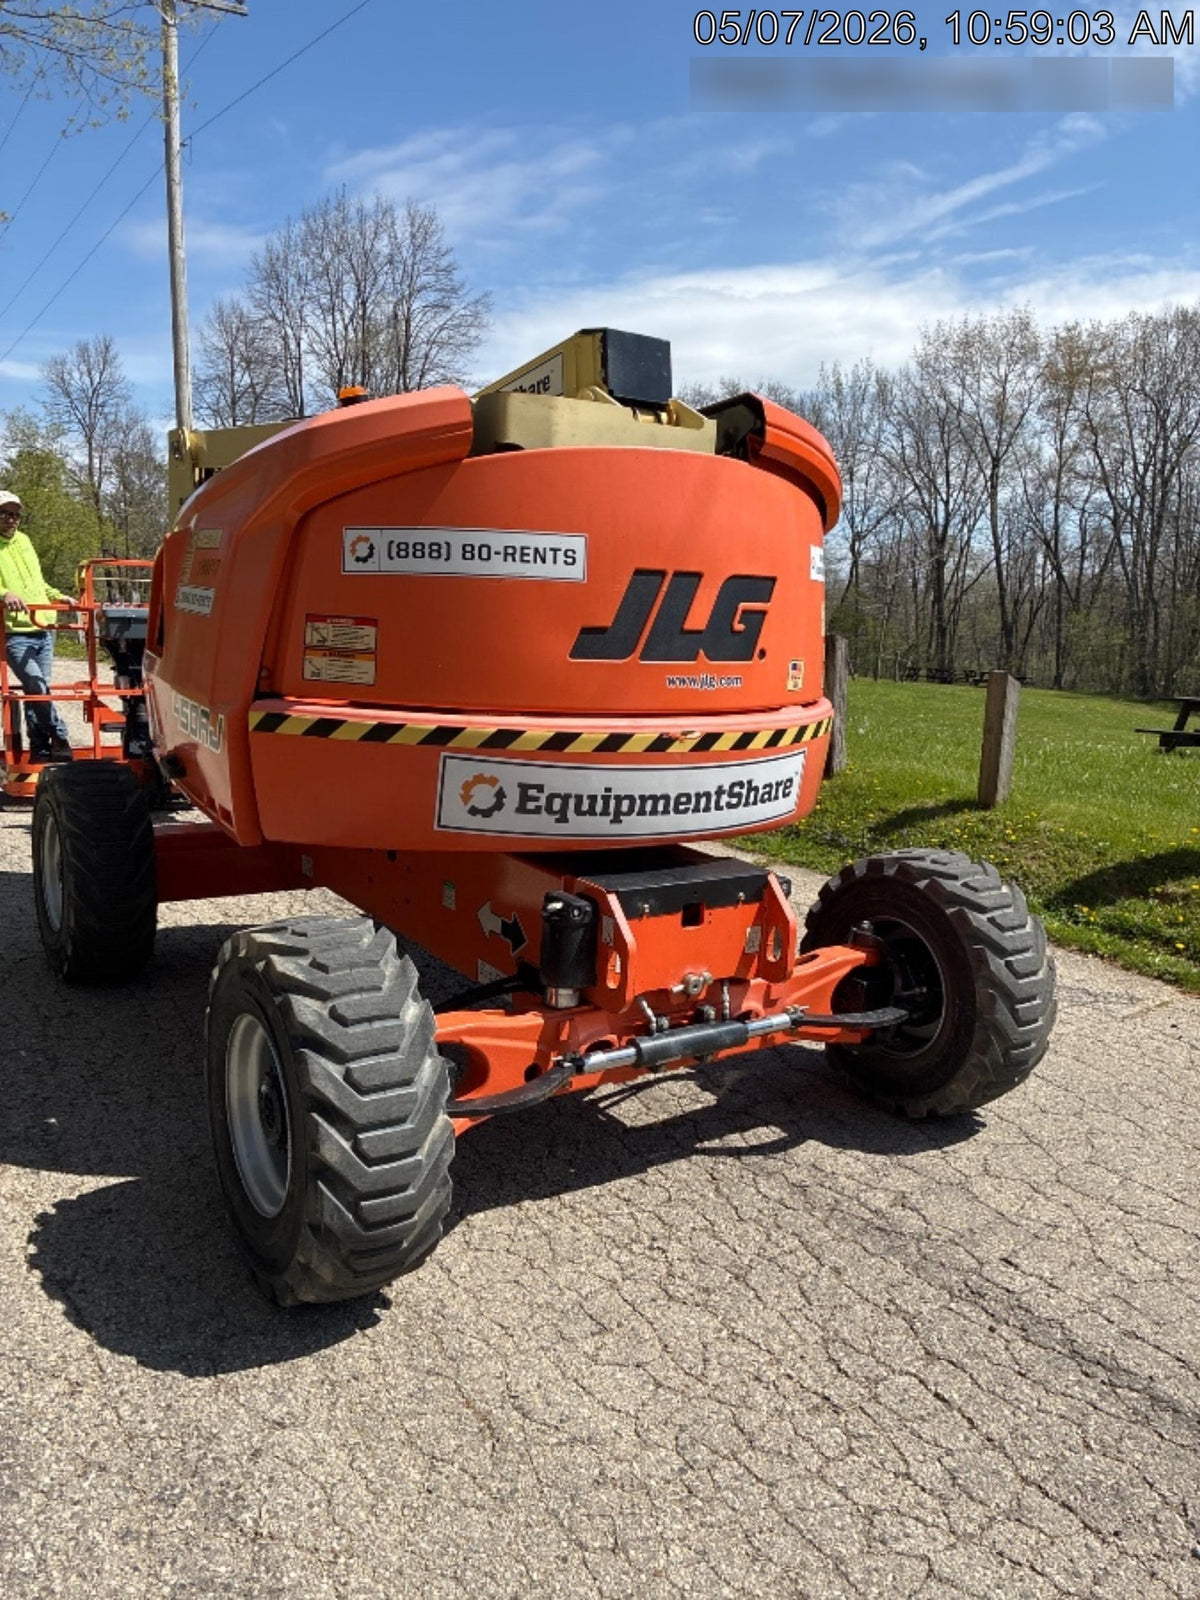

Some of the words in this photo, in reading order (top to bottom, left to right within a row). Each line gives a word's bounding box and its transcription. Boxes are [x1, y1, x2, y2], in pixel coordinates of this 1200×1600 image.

[387, 540, 451, 562] (888)
[461, 543, 577, 566] 80-RENTS
[568, 568, 777, 662] JLG
[666, 674, 743, 689] www.jlg.com
[514, 777, 794, 824] EquipmentShare
